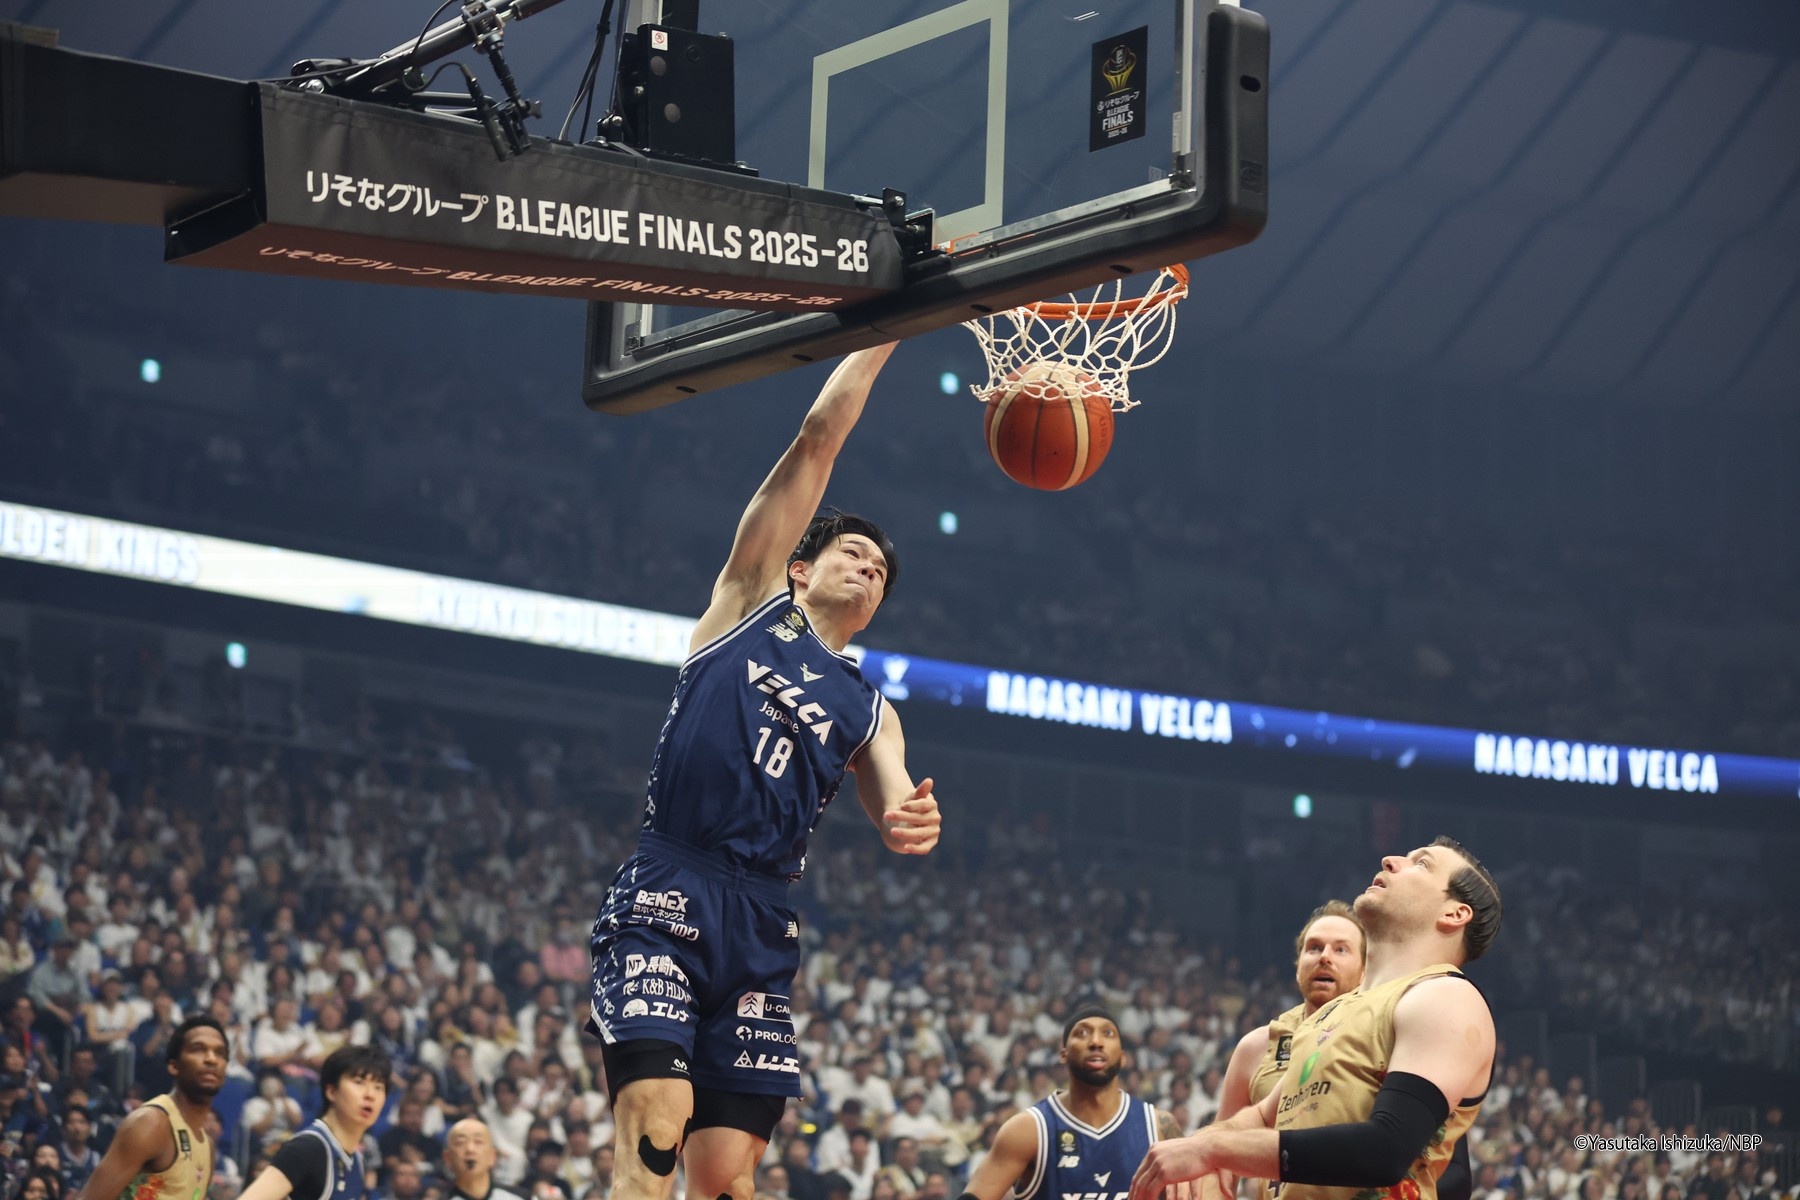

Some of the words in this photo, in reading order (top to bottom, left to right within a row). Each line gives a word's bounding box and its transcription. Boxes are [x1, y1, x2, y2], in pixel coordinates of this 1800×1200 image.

[1102, 110, 1134, 131] FINALS
[306, 170, 489, 223] りそなグループ
[496, 195, 630, 245] B.LEAGUE
[639, 213, 742, 260] FINALS
[750, 229, 869, 273] 2025-26
[260, 247, 451, 275] りそなグループ
[446, 271, 597, 287] B.LEAGUE
[593, 279, 711, 297] FINALS
[706, 290, 842, 305] 2025-26
[1, 506, 89, 564] LDEN
[98, 523, 200, 584] KINGS
[747, 658, 833, 746] VELCA
[987, 671, 1132, 731] NAGASAKI
[1140, 693, 1232, 744] VELCA
[753, 727, 794, 779] 18
[1475, 733, 1619, 785] NAGASAKI
[1628, 747, 1719, 794] VELCA
[632, 904, 685, 922] 日本ベネックス
[642, 978, 665, 996] K&B
